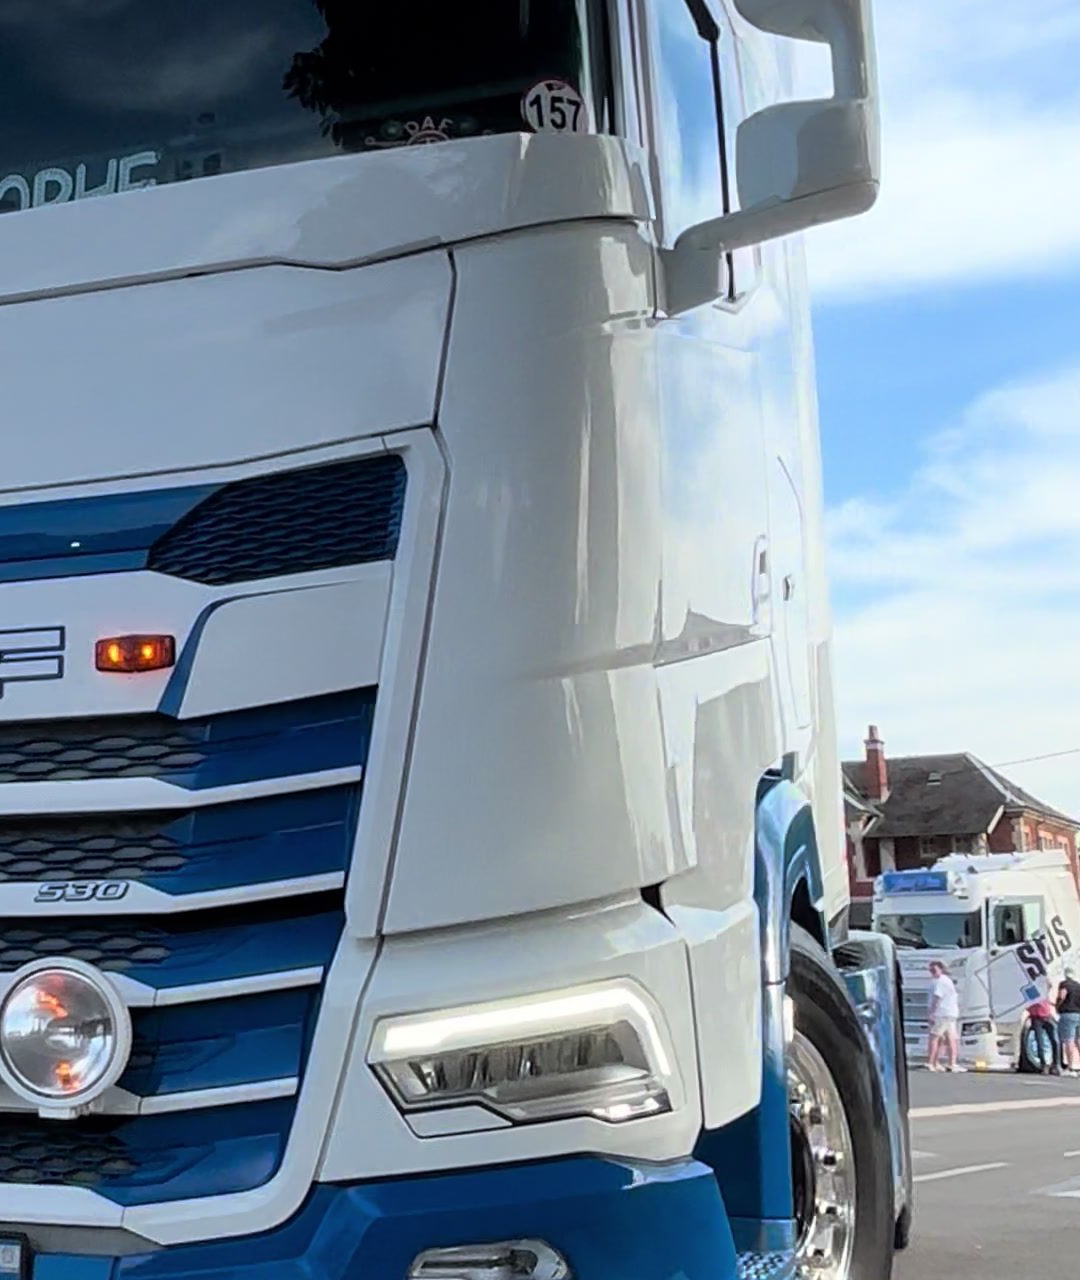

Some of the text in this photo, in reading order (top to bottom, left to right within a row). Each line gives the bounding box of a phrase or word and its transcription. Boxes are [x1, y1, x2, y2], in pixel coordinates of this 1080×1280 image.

[528, 94, 582, 132] 157
[405, 116, 454, 134] DAF
[33, 880, 130, 902] 530
